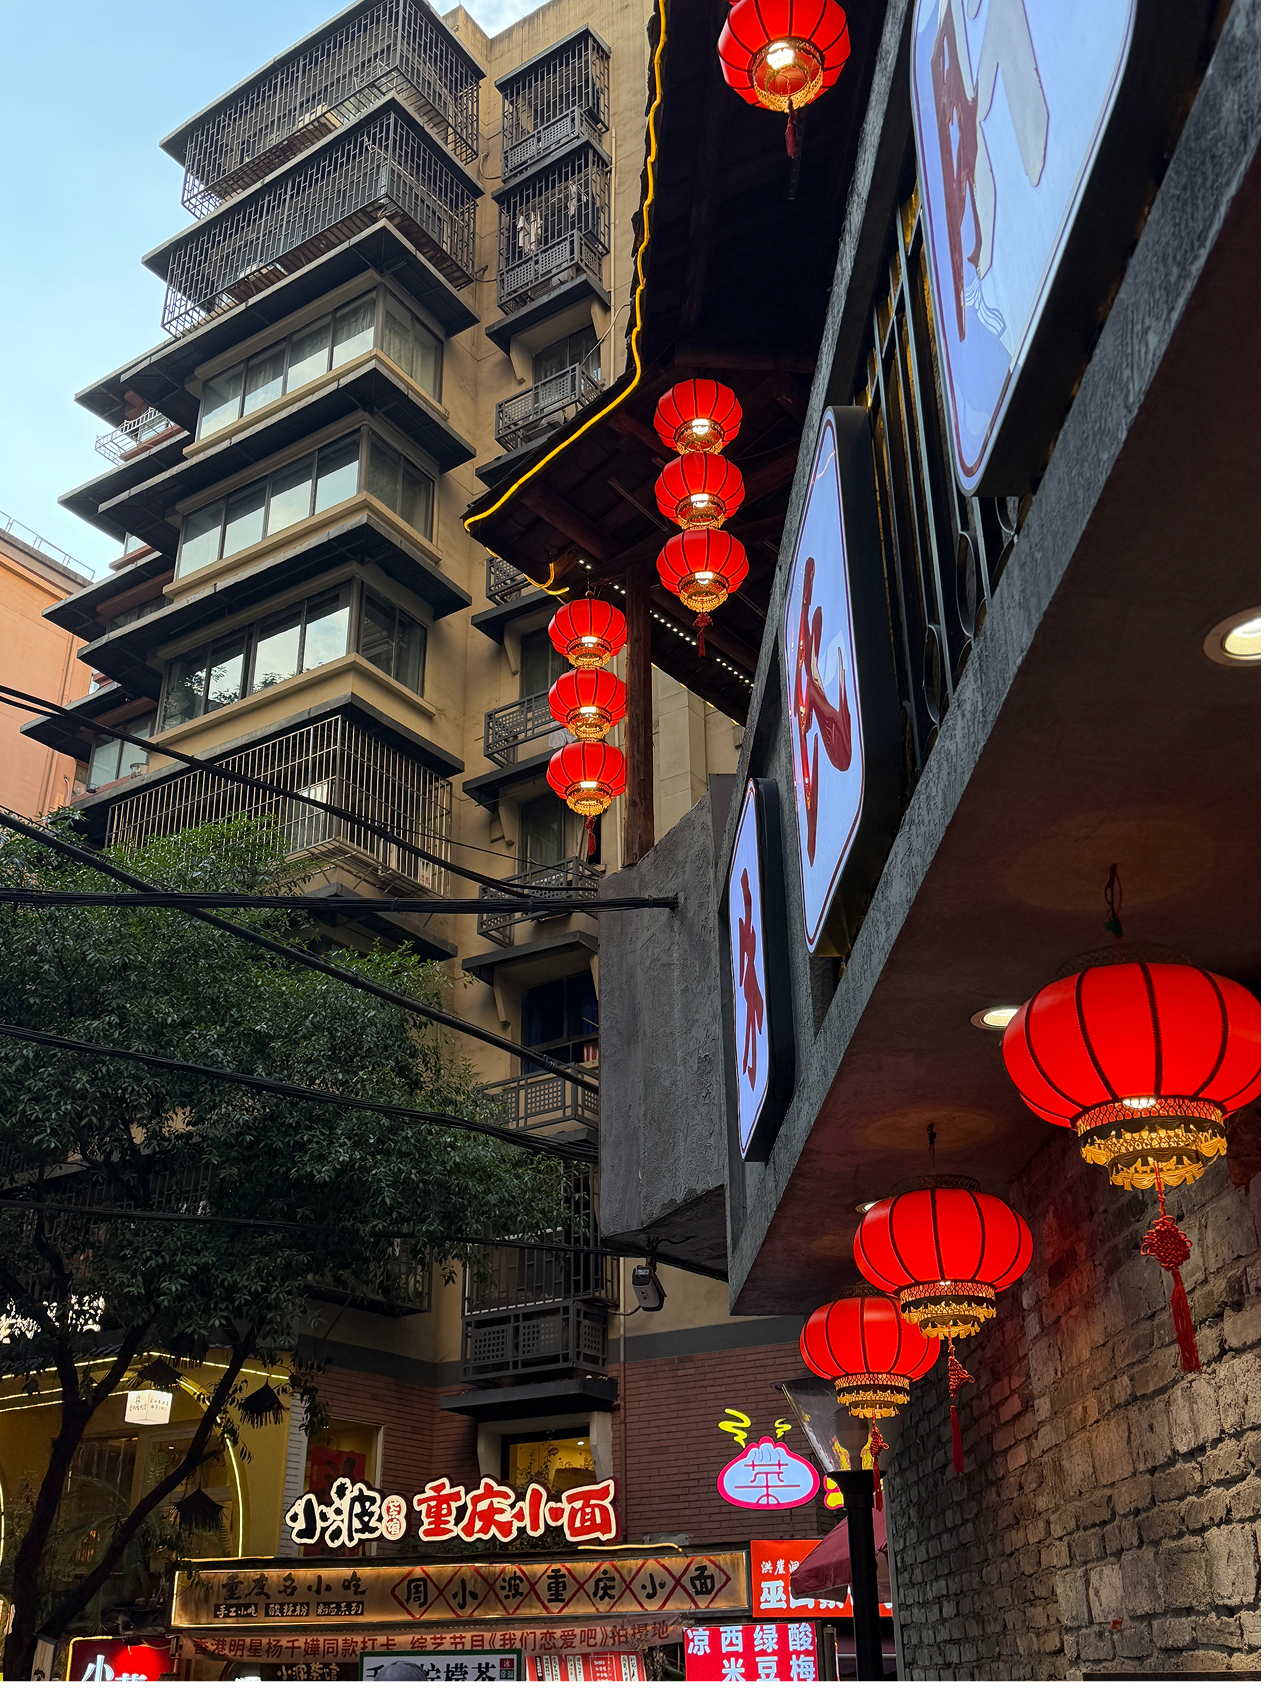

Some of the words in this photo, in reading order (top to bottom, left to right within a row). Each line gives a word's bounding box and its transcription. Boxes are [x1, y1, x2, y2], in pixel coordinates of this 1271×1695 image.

[413, 1477, 617, 1542] 重庆小面
[216, 1604, 258, 1619] 手工小吃
[268, 1603, 309, 1617] 酸辣粉
[316, 1601, 363, 1616] 粉面系列
[405, 1564, 715, 1609] 周小波重庆小面
[687, 1627, 711, 1656] 凉
[719, 1626, 746, 1682] 西米
[752, 1624, 779, 1682] 绿豆
[787, 1621, 815, 1682] 酸梅
